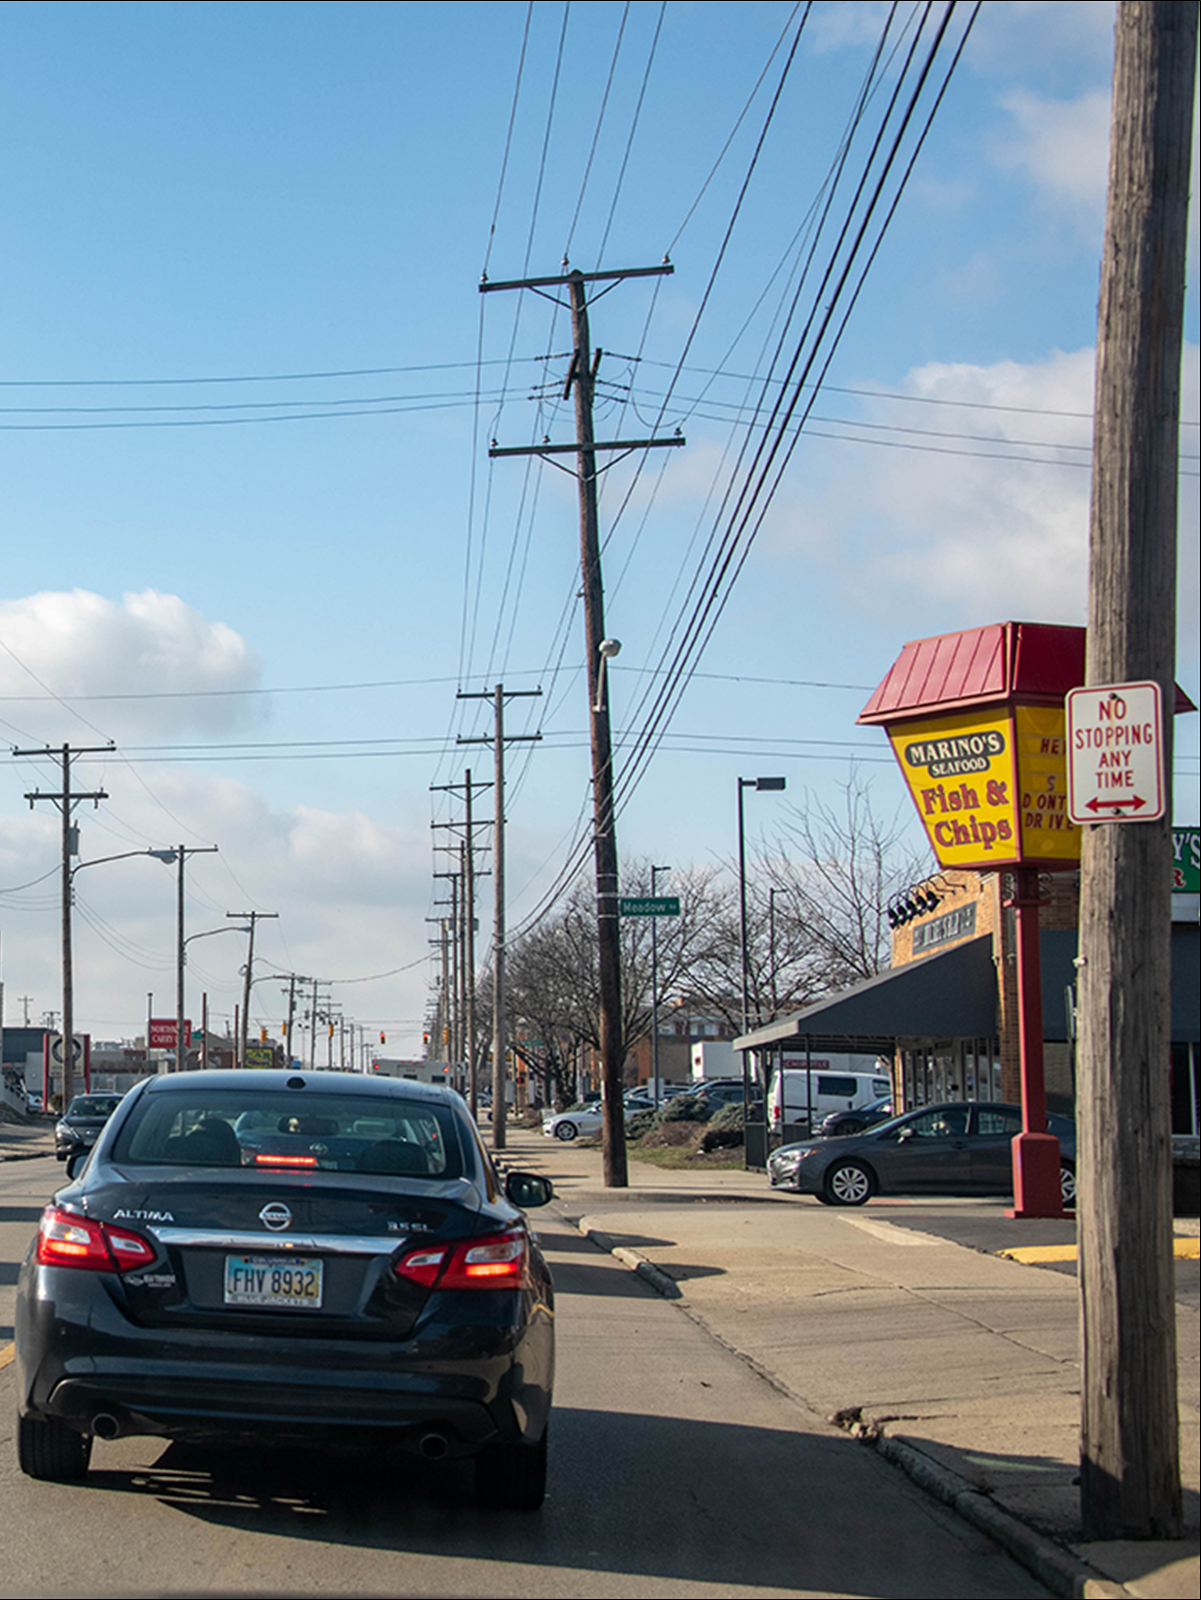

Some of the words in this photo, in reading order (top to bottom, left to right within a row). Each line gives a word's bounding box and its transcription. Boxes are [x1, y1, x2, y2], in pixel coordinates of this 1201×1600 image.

[1098, 699, 1126, 721] NO
[1074, 722, 1153, 750] STOPPING
[910, 733, 1001, 765] MARINO'S
[1098, 749, 1132, 768] ANY
[931, 756, 987, 777] SEAFOOD
[1094, 769, 1135, 789] TIME
[920, 783, 980, 815] Fish
[986, 779, 1009, 807] &
[934, 814, 1012, 850] Chips
[623, 901, 666, 913] Meadow
[113, 1209, 175, 1222] ALTIMA
[233, 1268, 266, 1293] FHV
[271, 1269, 315, 1296] 8932
